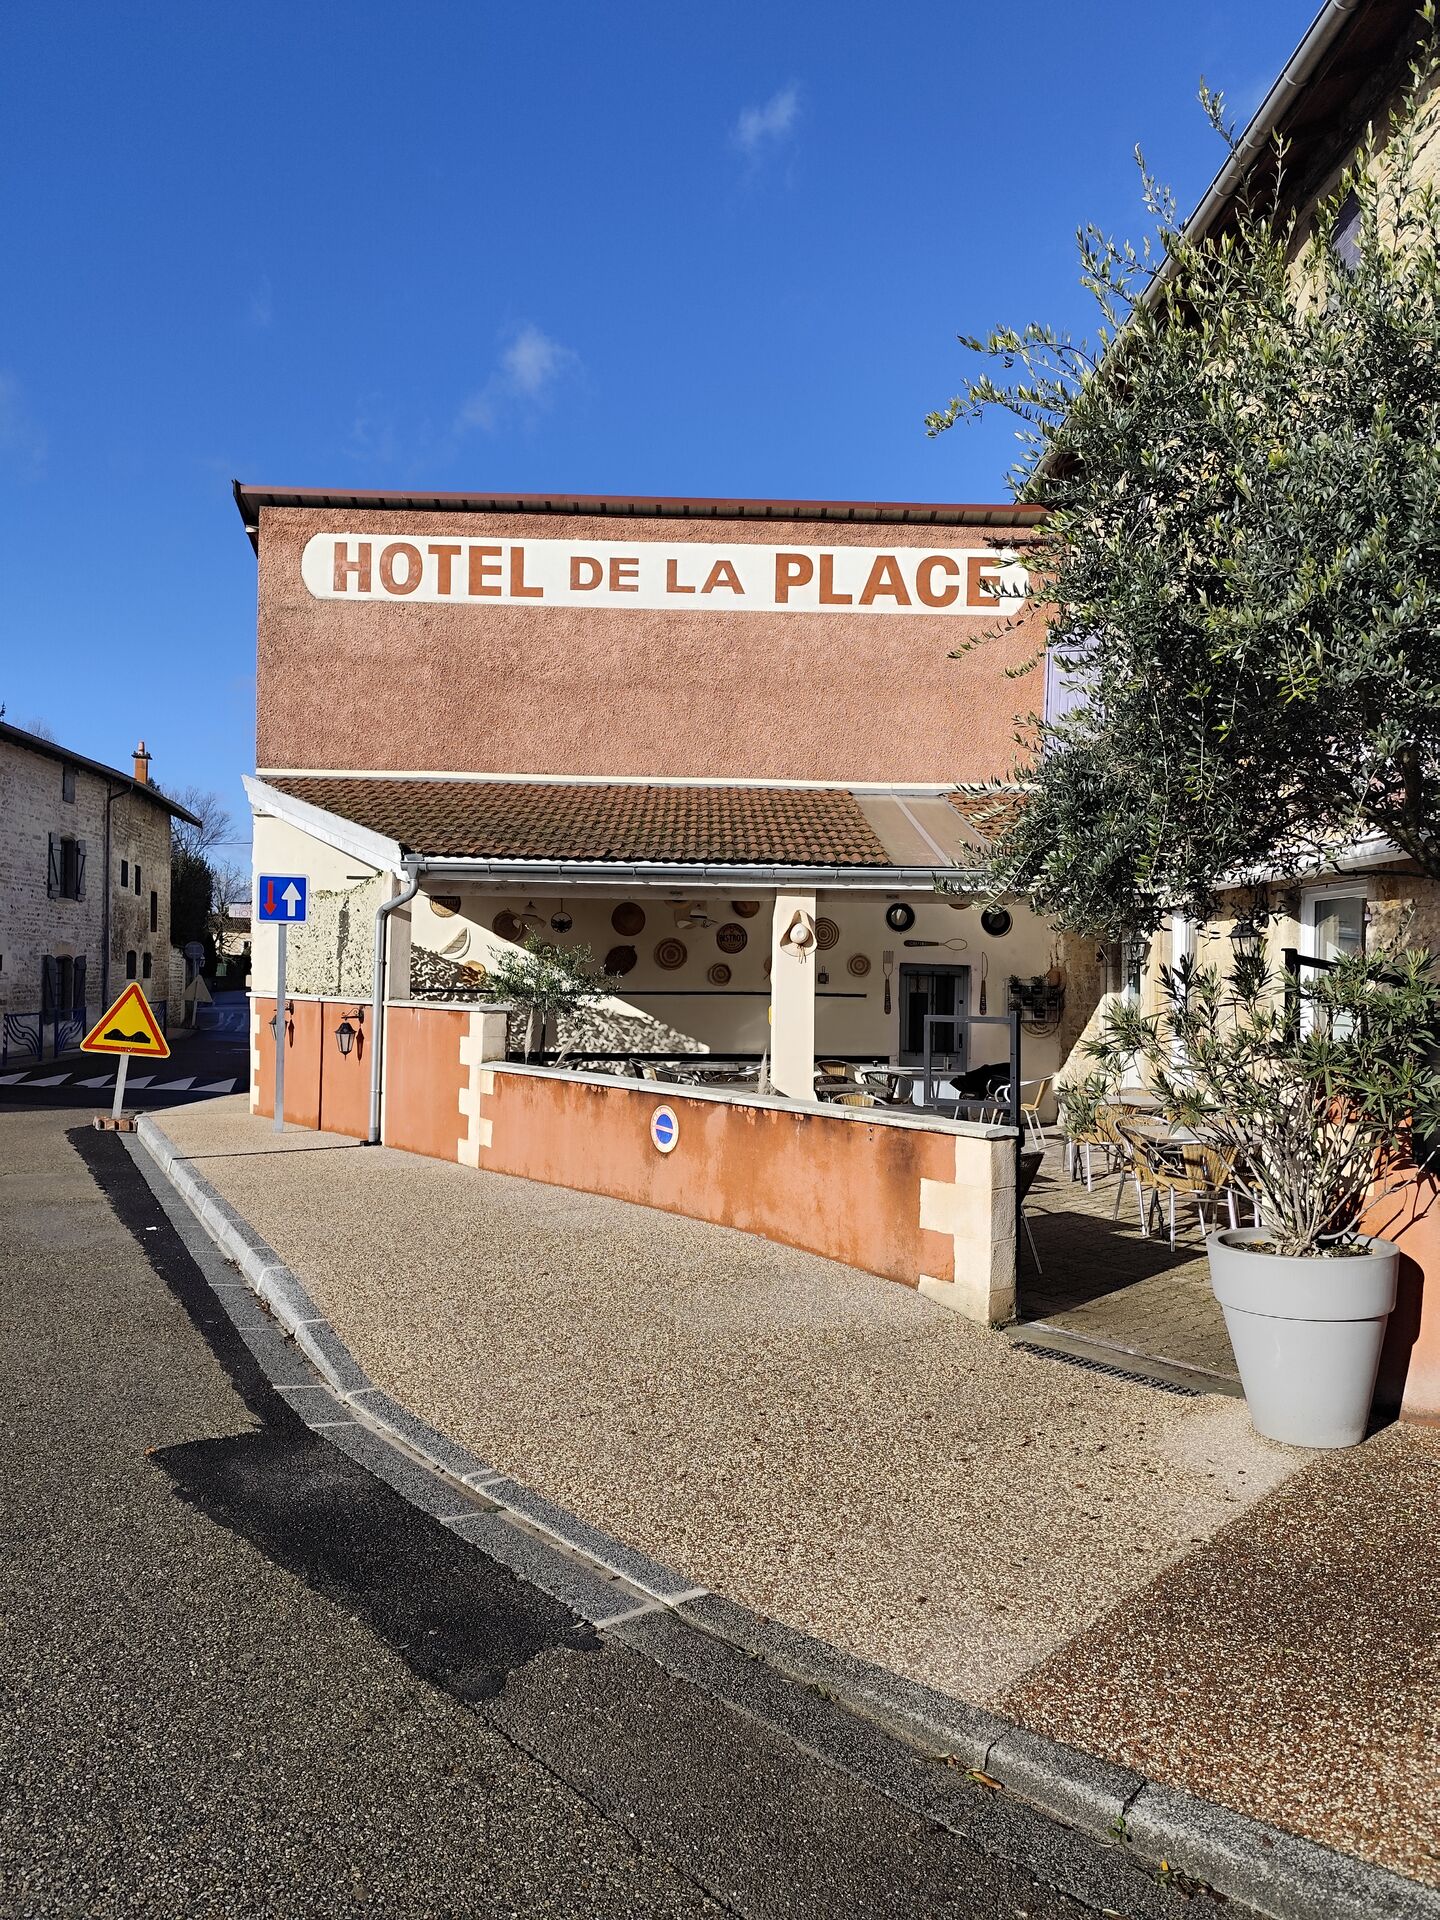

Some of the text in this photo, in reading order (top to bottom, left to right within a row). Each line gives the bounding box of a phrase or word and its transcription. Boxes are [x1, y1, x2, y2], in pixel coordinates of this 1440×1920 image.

[333, 542, 1001, 609] HOTEL DE LA PLACE
